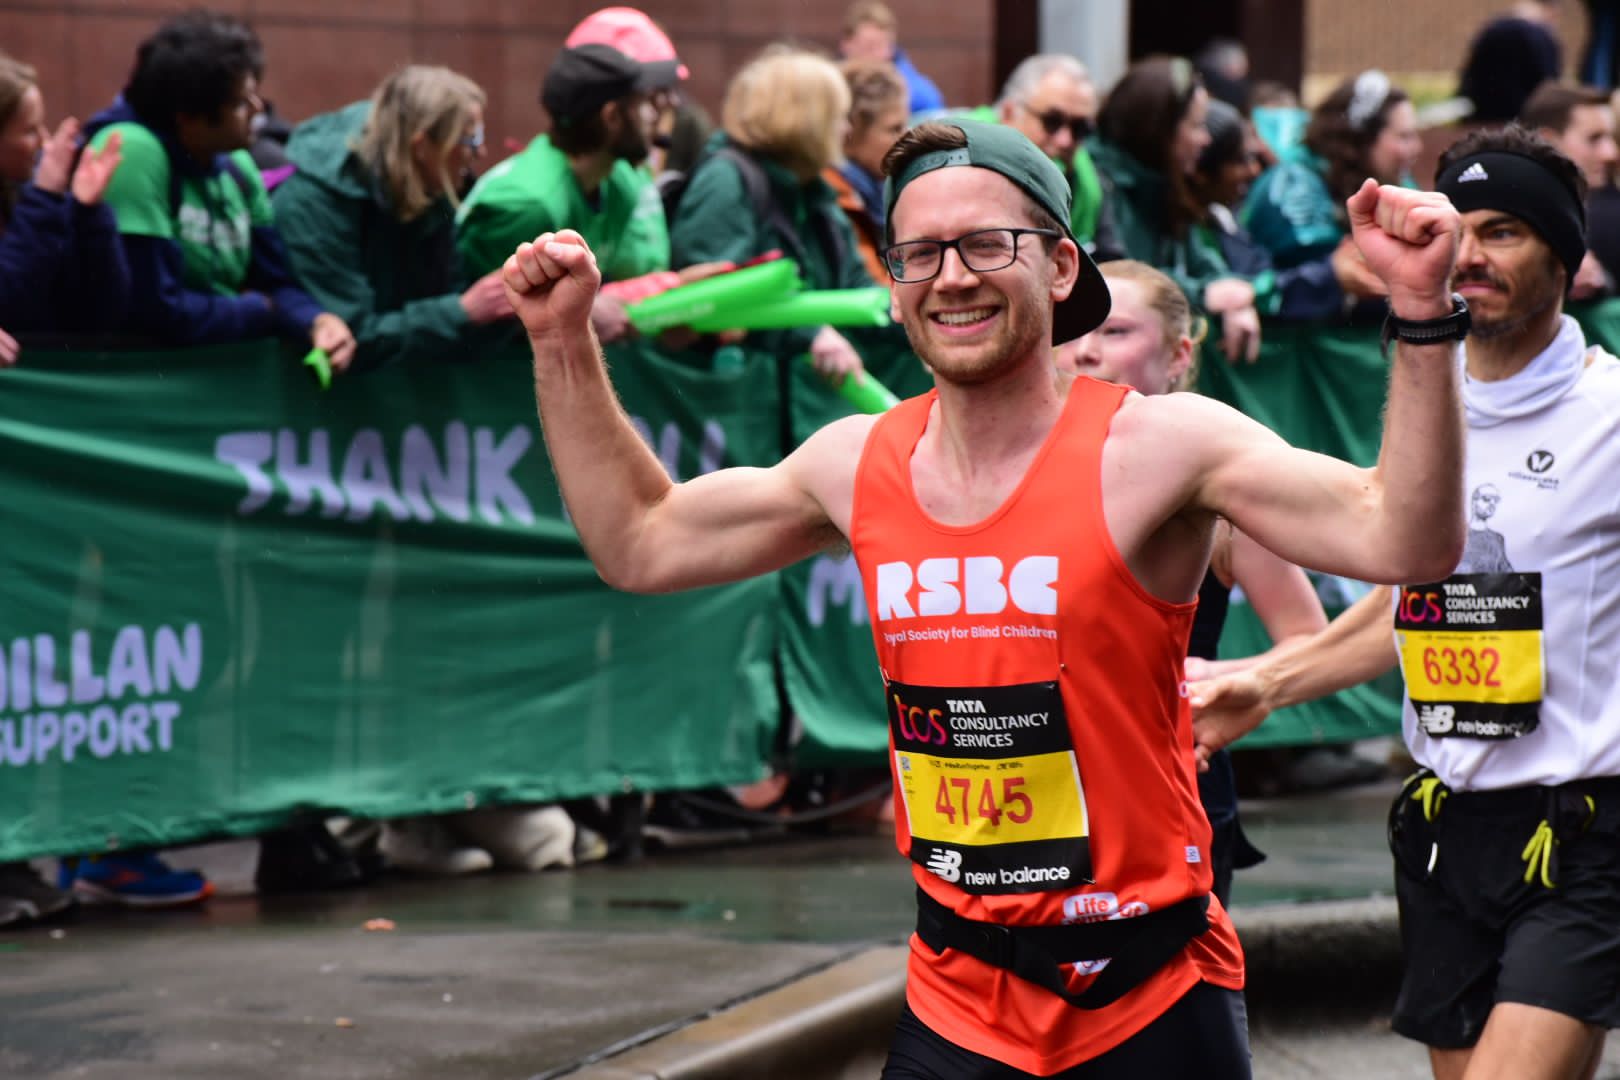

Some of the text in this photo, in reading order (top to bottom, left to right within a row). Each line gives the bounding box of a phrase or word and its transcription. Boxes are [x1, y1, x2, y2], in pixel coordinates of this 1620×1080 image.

[214, 421, 536, 527] THANK
[876, 556, 1059, 621] RSBC
[1443, 584, 1476, 596] TATA
[1445, 596, 1530, 610] CONSULTANCY
[1446, 610, 1497, 624] SERVICES
[884, 624, 1058, 647] oyal Society for Blind Children
[0, 622, 202, 714] ILLAN
[1423, 647, 1501, 687] 6332
[946, 700, 987, 713] TATA
[894, 694, 947, 745] tcs
[950, 712, 1049, 731] CONSULTANCY
[952, 733, 1014, 748] SERVICES
[935, 776, 1033, 826] 4745
[965, 866, 1070, 885] new balance
[1074, 897, 1109, 915] Life
